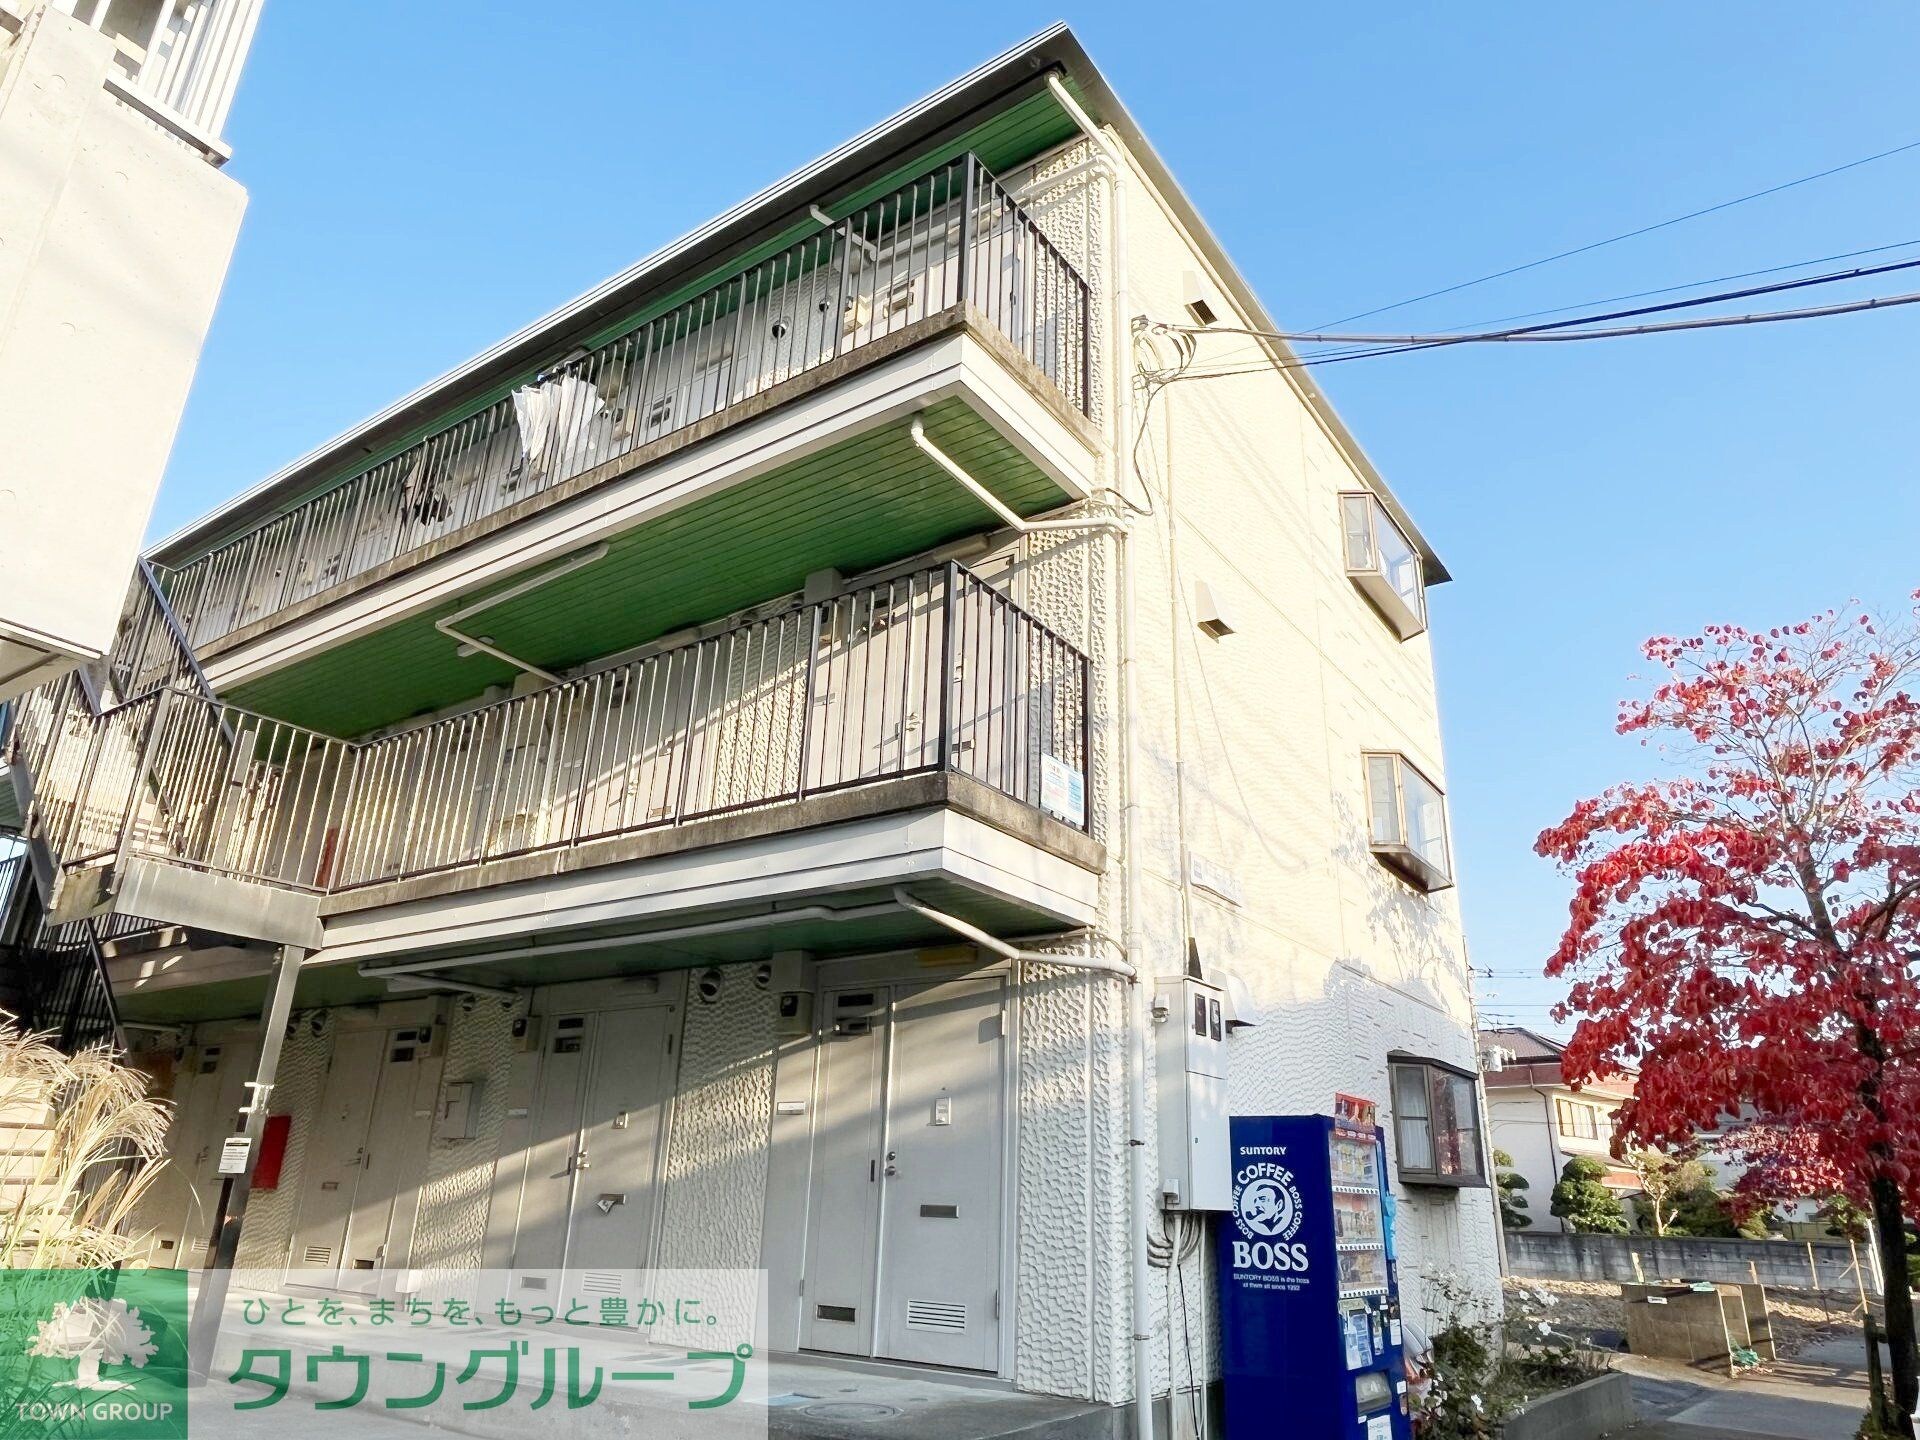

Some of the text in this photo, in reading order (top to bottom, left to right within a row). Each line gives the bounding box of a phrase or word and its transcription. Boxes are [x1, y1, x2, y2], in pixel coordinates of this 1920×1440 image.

[1237, 1162, 1294, 1187] COFFEE
[1288, 1185, 1303, 1210] BOSS
[1232, 1241, 1309, 1272] BOSS
